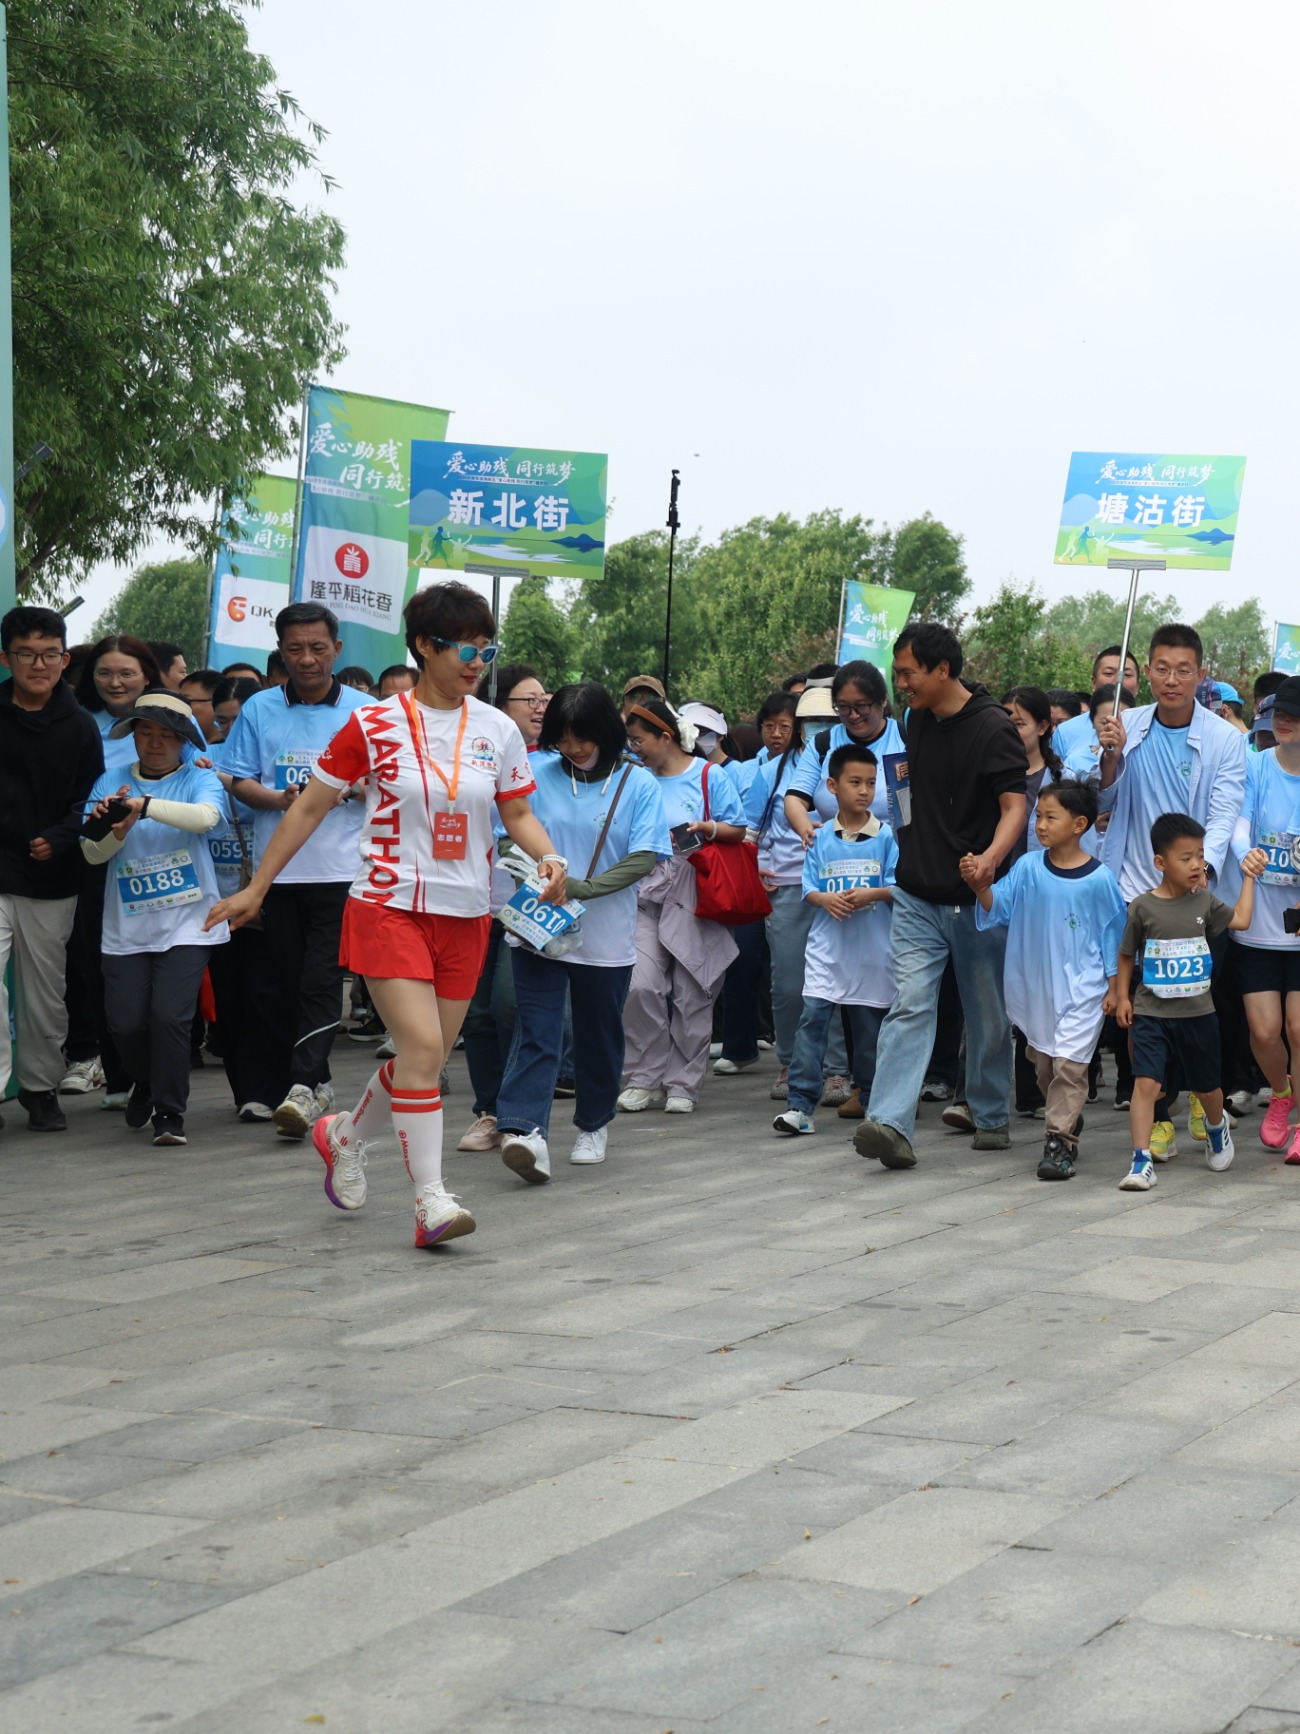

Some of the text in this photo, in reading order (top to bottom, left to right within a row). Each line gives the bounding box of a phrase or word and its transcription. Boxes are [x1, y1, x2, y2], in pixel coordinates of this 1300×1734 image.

[307, 422, 403, 470] 爱心助残
[340, 464, 410, 500] 同行筑
[443, 451, 576, 486] 爱心助残 同行筑梦
[1095, 459, 1215, 487] 爱心助残 同行筑梦
[447, 488, 569, 532] 新北街
[1095, 492, 1205, 527] 塘沽街
[253, 528, 293, 549] 同行
[310, 580, 393, 613] 隆平稻花香
[1268, 848, 1294, 868] 10
[129, 869, 184, 895] 0188
[826, 876, 870, 893] 0175
[1154, 957, 1204, 978] 1023
